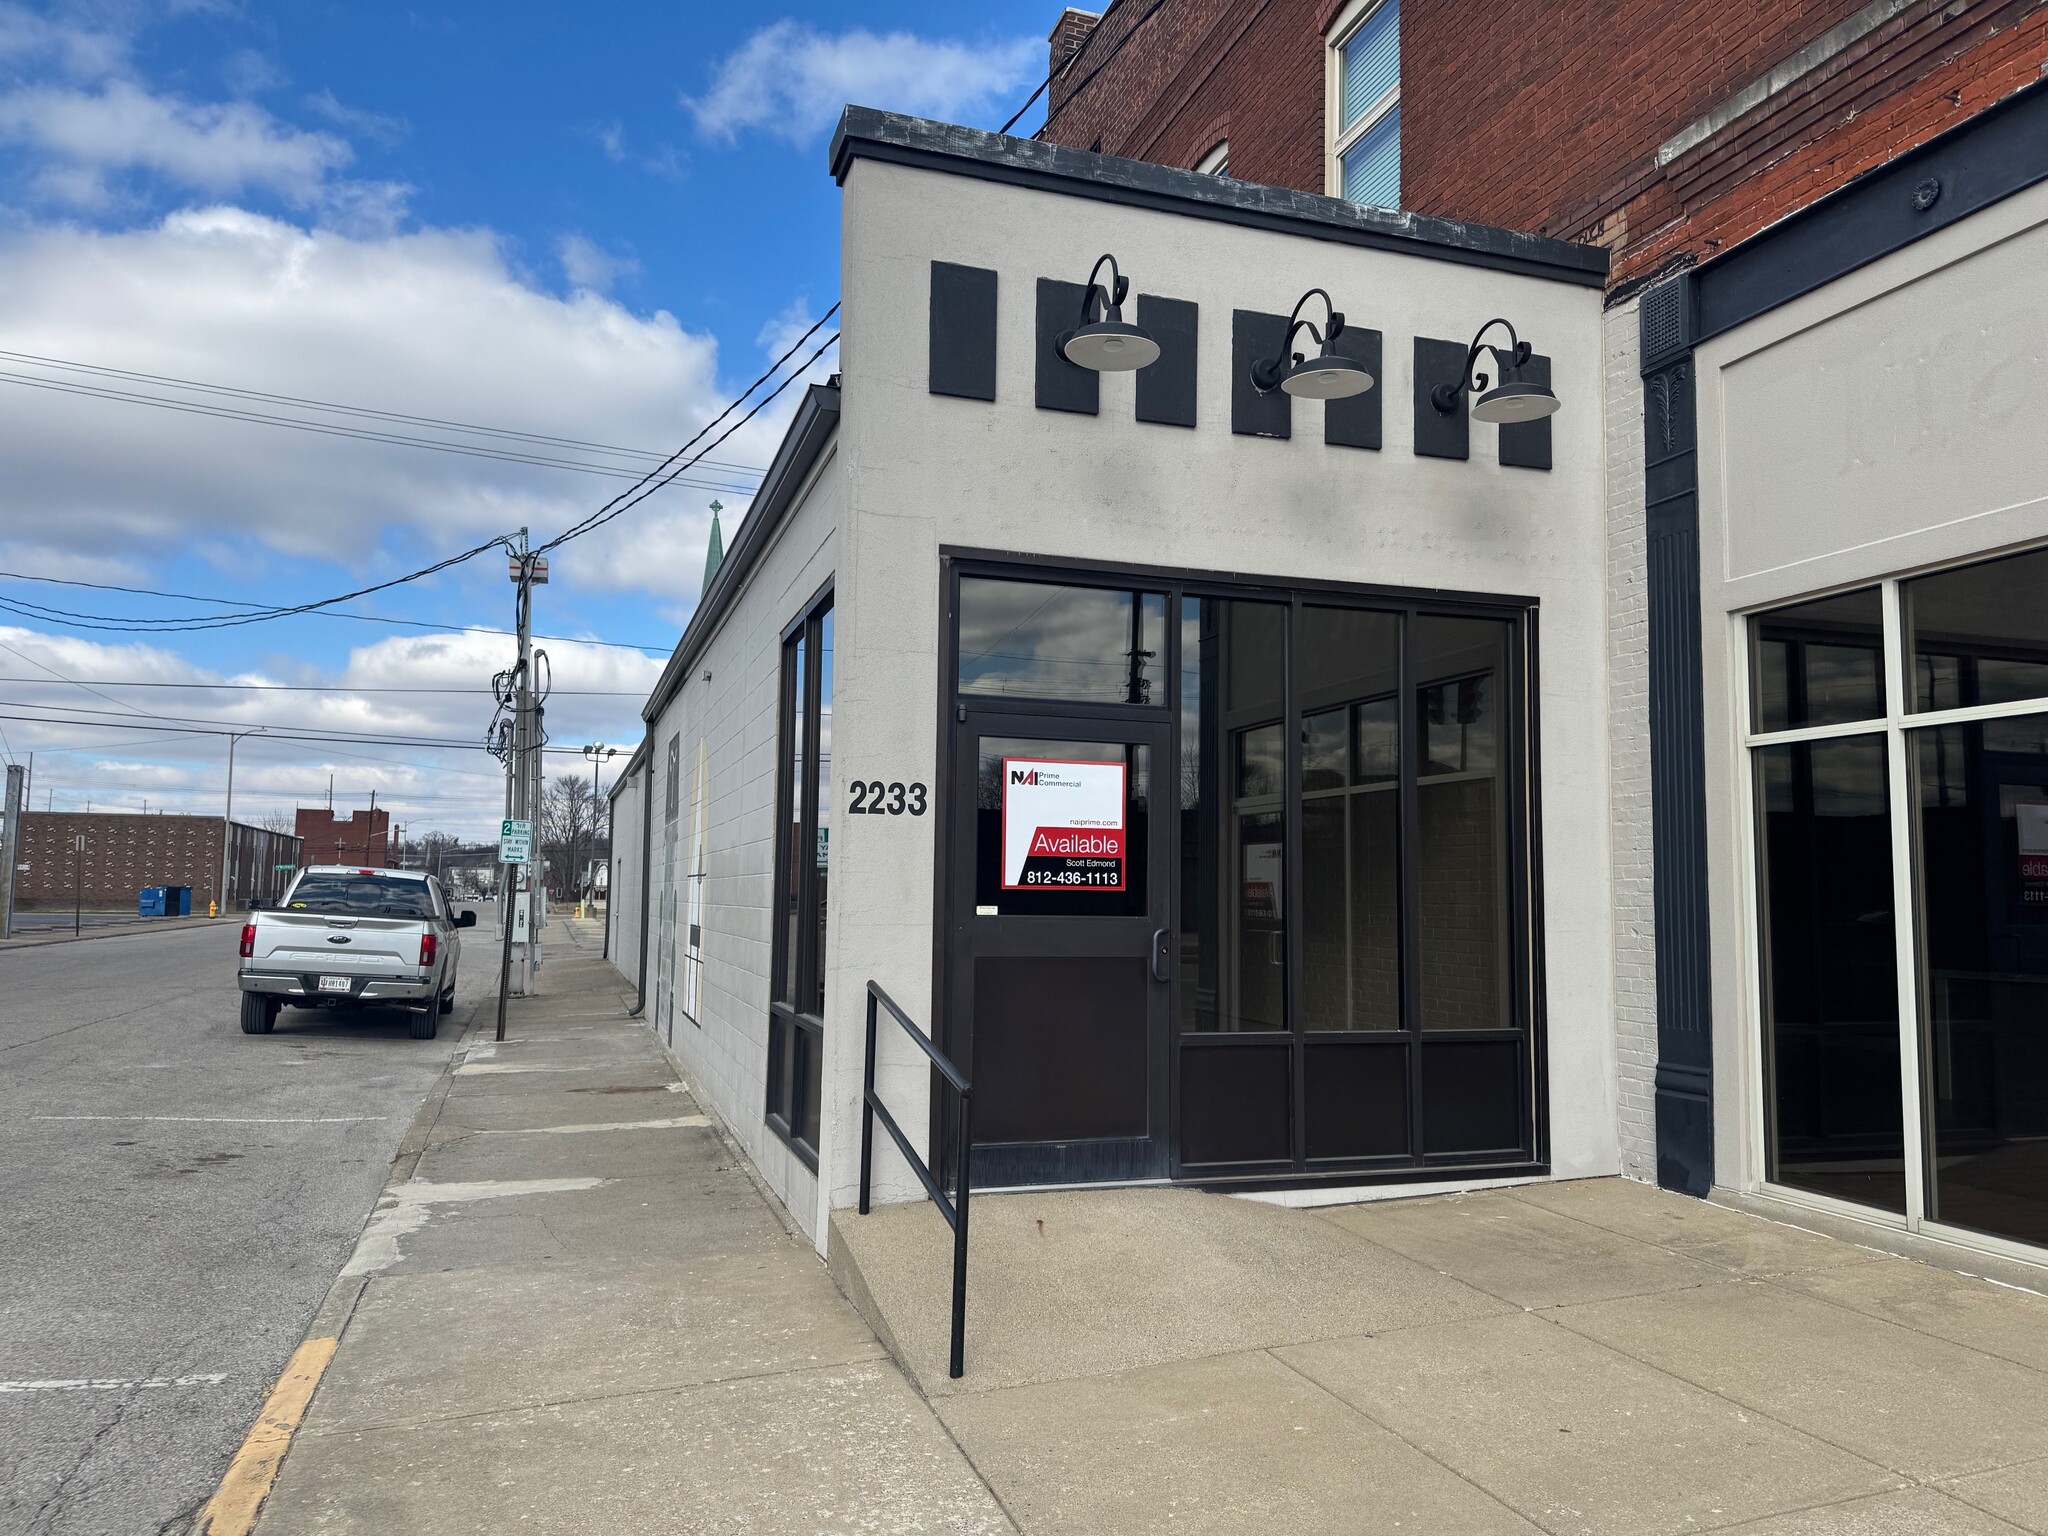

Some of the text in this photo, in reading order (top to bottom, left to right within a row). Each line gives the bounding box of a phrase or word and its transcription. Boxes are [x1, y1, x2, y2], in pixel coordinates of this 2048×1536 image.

[1011, 768, 1038, 785] NAI
[1039, 779, 1081, 787] Commercial
[848, 780, 928, 816] 2233
[503, 822, 511, 833] 2
[1069, 819, 1118, 827] naiprime.com
[1034, 833, 1118, 854] Available
[1065, 859, 1116, 868] Scott Edmond
[1027, 871, 1118, 885] 812-436-1113
